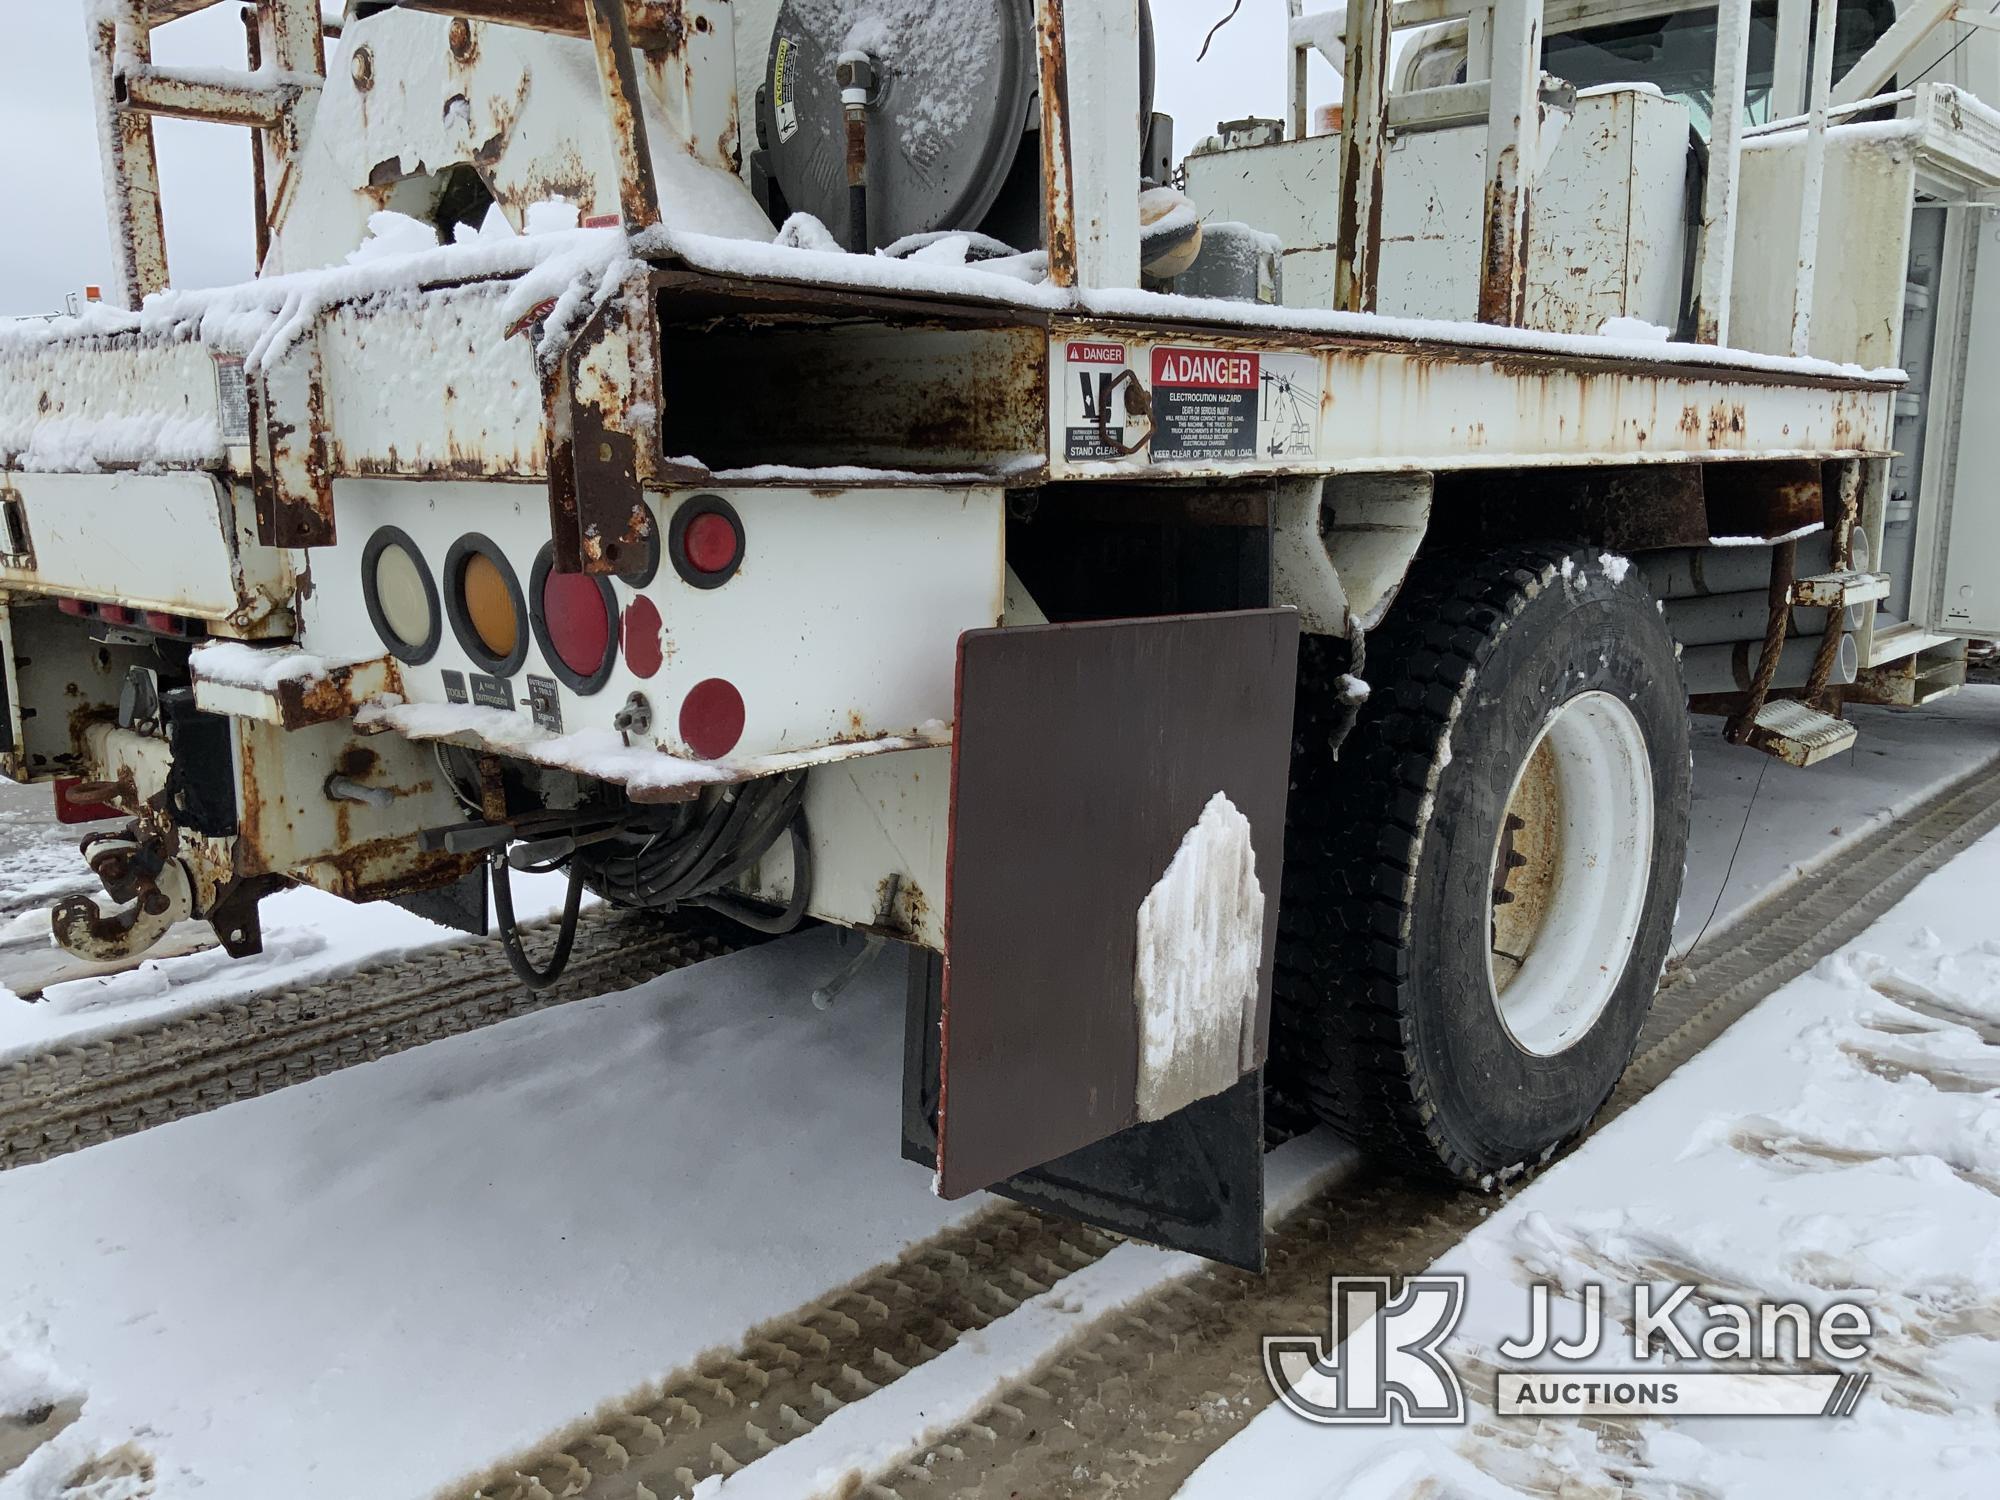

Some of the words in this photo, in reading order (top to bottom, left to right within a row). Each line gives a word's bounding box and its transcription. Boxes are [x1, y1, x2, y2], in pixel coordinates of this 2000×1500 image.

[776, 45, 786, 92] CAUTION
[1083, 347, 1122, 361] DANGER
[1179, 355, 1250, 384] DANGER
[1169, 392, 1217, 402] ELECTROCUTION
[1218, 394, 1242, 403] HAZARD
[1181, 405, 1193, 415] DEATH
[1194, 406, 1200, 415] OR
[1200, 406, 1216, 415] SERIOUS
[1070, 446, 1094, 457] STAND
[1153, 449, 1170, 458] KEEP
[1171, 450, 1191, 458] CLEAR
[1192, 449, 1201, 458] OF
[1202, 449, 1222, 458] TRUCK
[1223, 448, 1236, 457] AND
